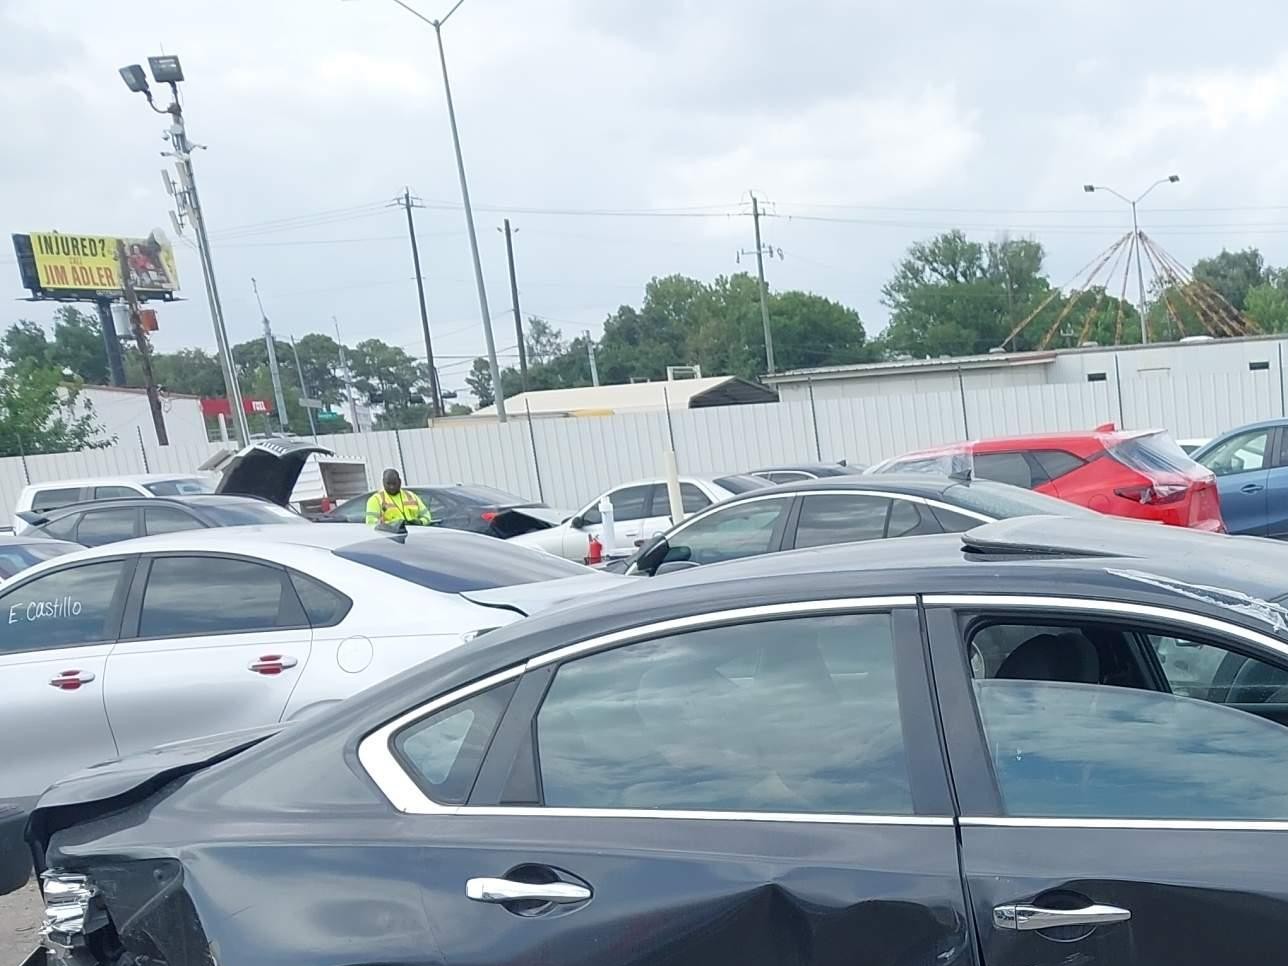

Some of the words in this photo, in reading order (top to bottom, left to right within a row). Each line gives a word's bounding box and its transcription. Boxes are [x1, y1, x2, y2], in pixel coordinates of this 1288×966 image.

[37, 235, 106, 258] INJURED?
[44, 265, 69, 286] JIM
[71, 266, 116, 287] ADLER
